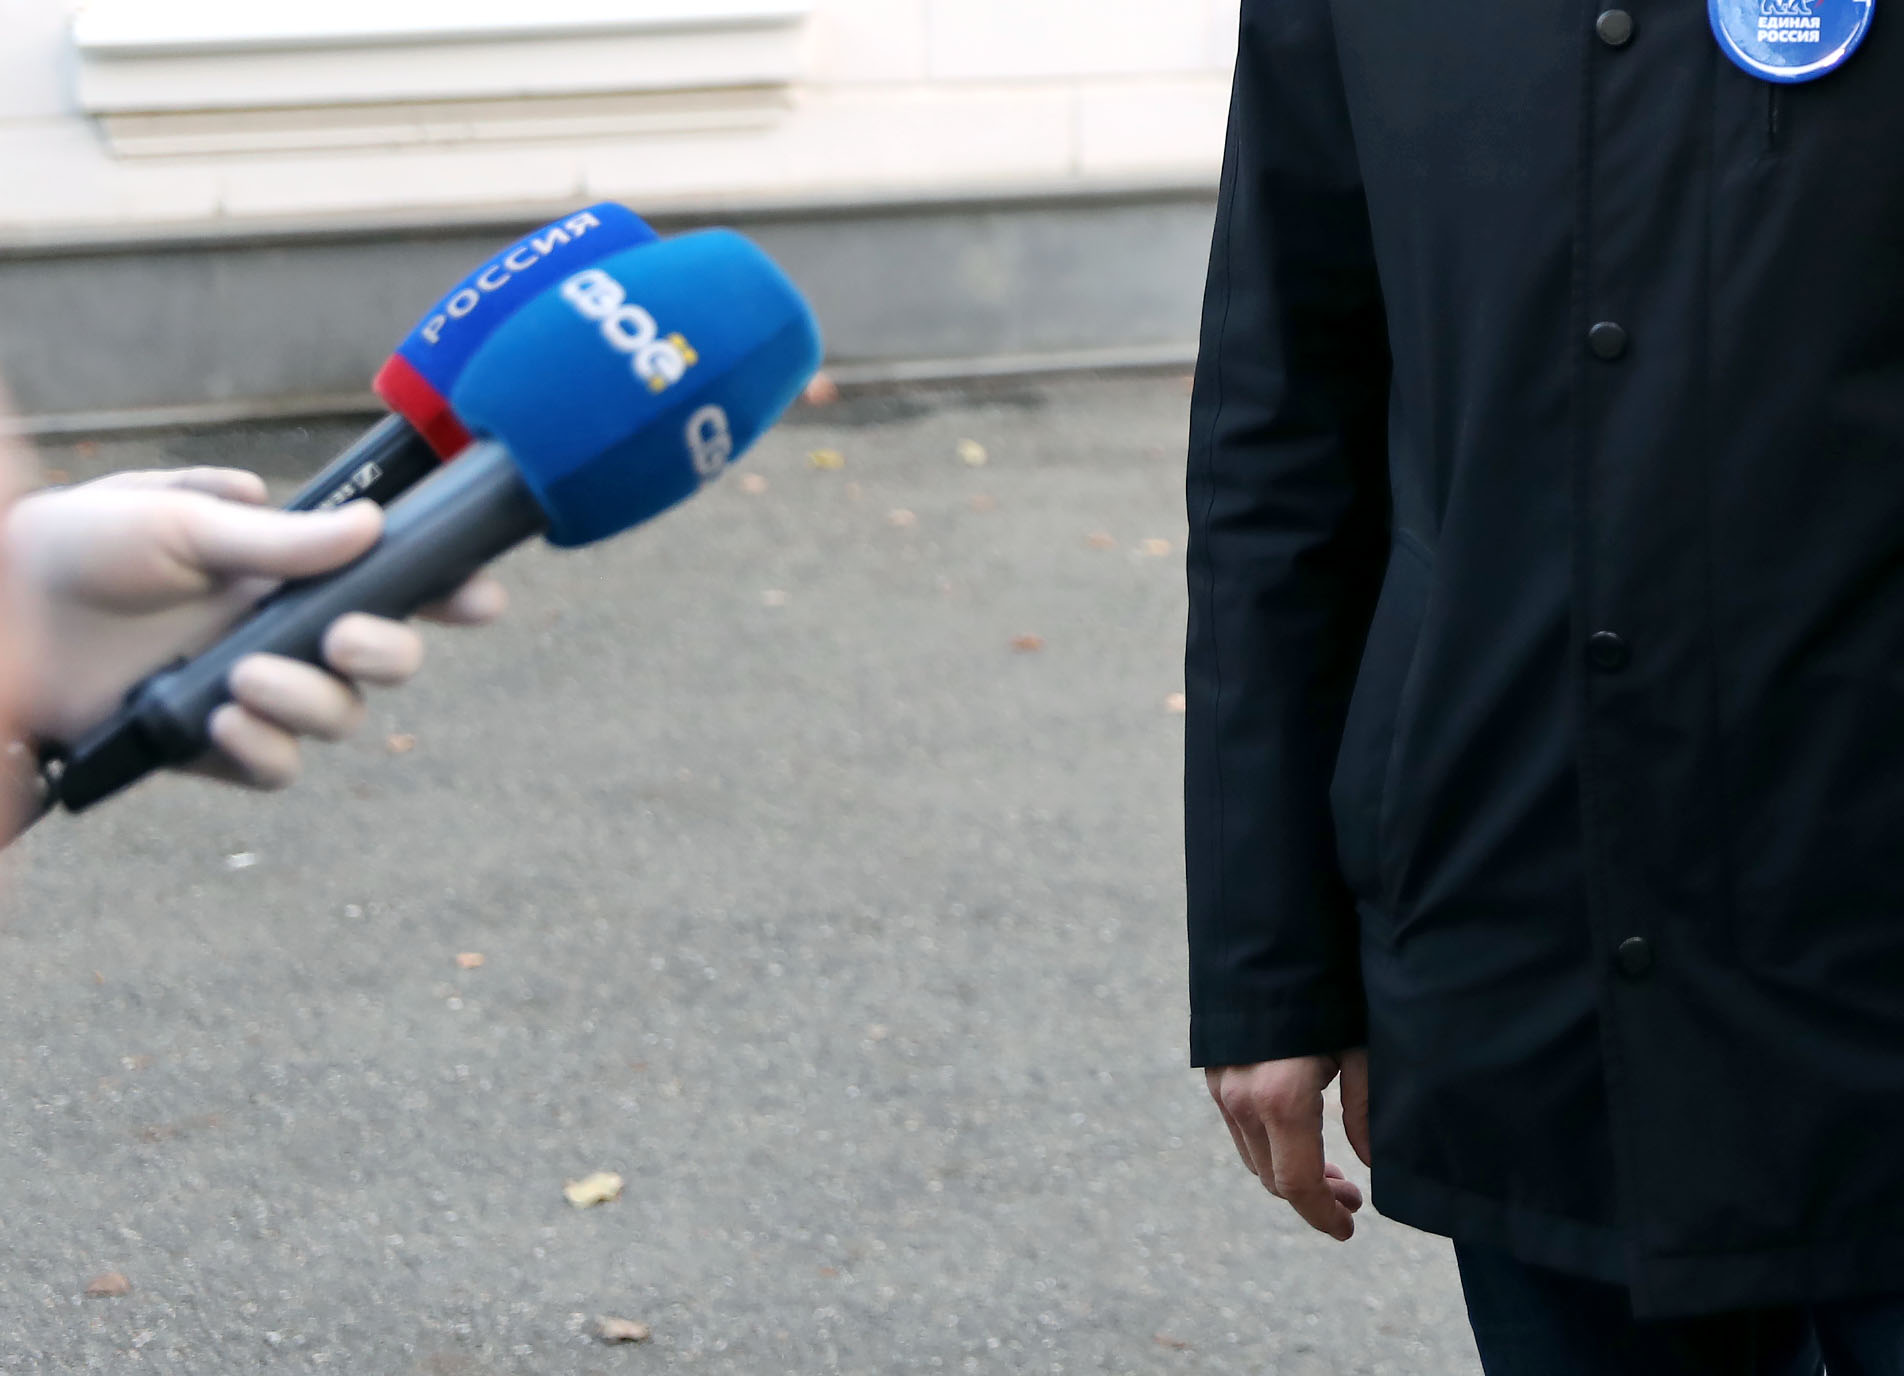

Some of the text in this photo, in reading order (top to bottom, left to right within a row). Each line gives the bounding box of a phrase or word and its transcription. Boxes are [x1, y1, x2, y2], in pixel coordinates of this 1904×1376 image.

[1757, 16, 1821, 30] ЕДИНАЯ
[1757, 30, 1821, 43] РОССИЯ
[421, 211, 602, 345] РОССИЯ
